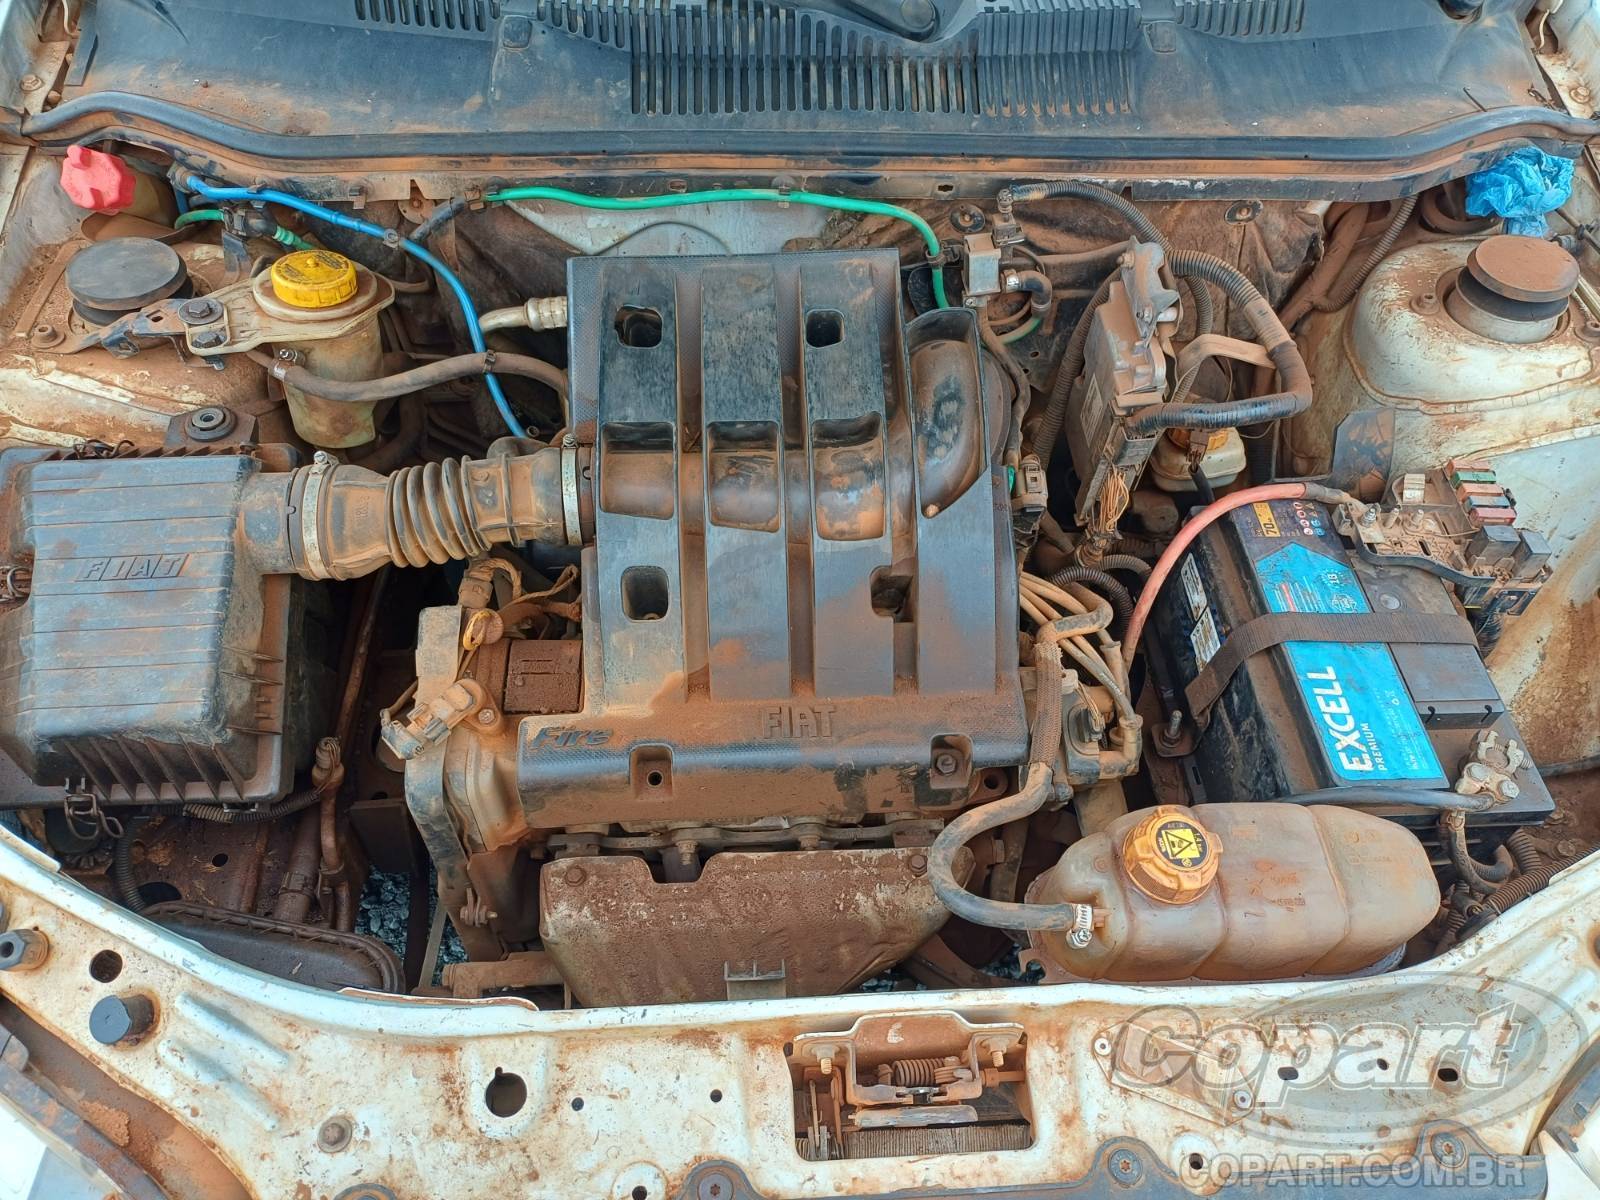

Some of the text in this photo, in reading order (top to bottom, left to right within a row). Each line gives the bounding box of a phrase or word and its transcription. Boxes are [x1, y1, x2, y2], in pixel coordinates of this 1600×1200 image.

[1263, 523, 1277, 535] 70
[84, 555, 182, 580] FIAT
[762, 705, 838, 738] FIAT
[1306, 666, 1374, 772] EXCELL
[531, 727, 612, 750] Fire
[1360, 722, 1388, 771] PREMIUM
